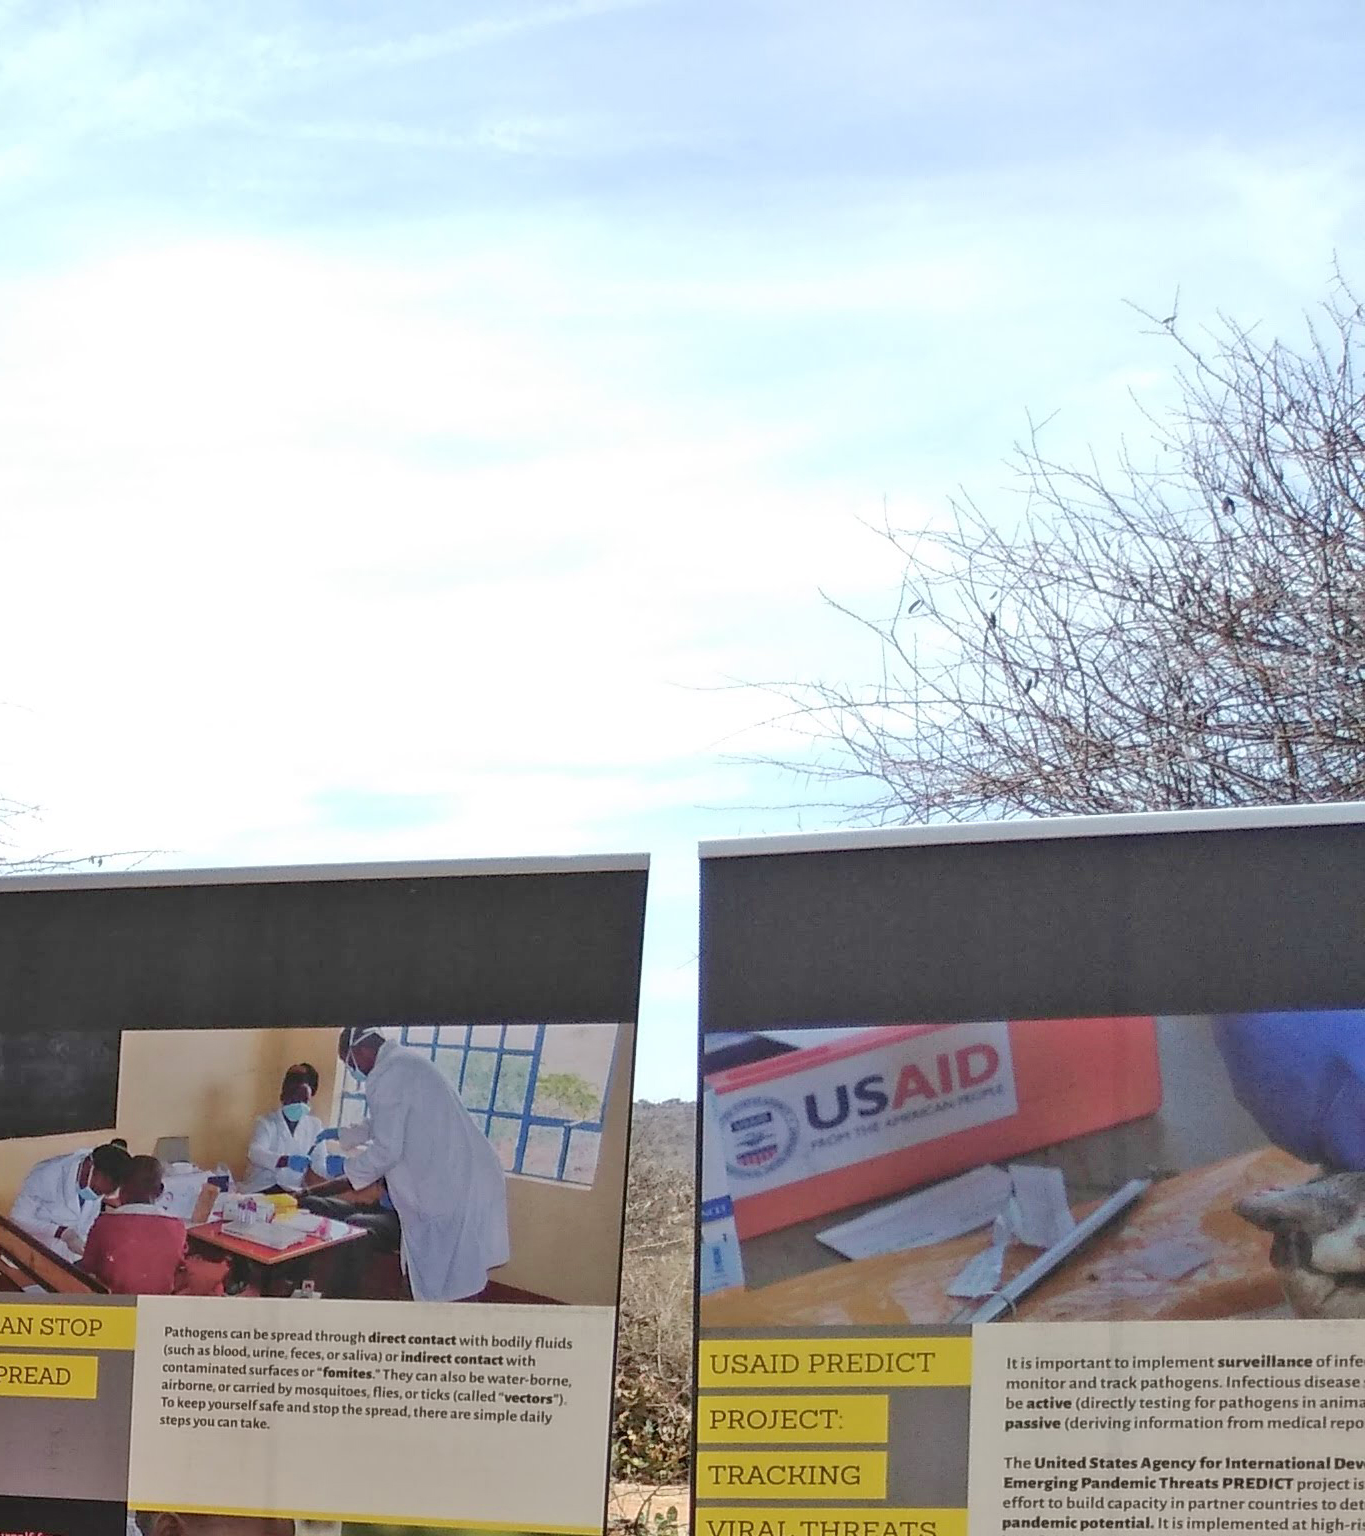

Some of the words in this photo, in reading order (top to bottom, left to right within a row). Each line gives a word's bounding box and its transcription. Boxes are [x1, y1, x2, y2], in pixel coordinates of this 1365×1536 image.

[805, 1043, 999, 1129] USAID
[39, 1317, 103, 1336] STOP
[164, 1326, 227, 1340] Pathogens
[229, 1330, 250, 1339] can
[253, 1328, 268, 1339] be
[270, 1330, 312, 1342] spread
[315, 1330, 365, 1345] through
[367, 1331, 406, 1343] direct
[407, 1335, 456, 1345] contact
[459, 1334, 488, 1346] with
[491, 1335, 532, 1350] bodily
[535, 1336, 573, 1349] fluids
[709, 1353, 799, 1373] USAID
[807, 1352, 936, 1372] PREDICT
[1007, 1357, 1017, 1369] It
[1020, 1356, 1031, 1369] is
[1035, 1357, 1111, 1371] important
[1114, 1358, 1129, 1368] to
[1132, 1355, 1214, 1370] implement
[1217, 1355, 1312, 1367] surveillance
[1315, 1354, 1331, 1367] of
[1005, 1377, 1066, 1389] monitor
[1068, 1376, 1096, 1388] and
[1100, 1376, 1136, 1388] track
[1140, 1376, 1222, 1391] pathogens.
[1226, 1375, 1300, 1388] Infectious
[1304, 1375, 1360, 1388] disease
[709, 1410, 843, 1430] PROJECT:
[1003, 1456, 1031, 1468] The
[1034, 1456, 1086, 1468] United
[1089, 1457, 1137, 1468] States
[1140, 1457, 1196, 1471] Agency
[1199, 1456, 1222, 1468] for
[1225, 1456, 1331, 1469] International
[708, 1466, 861, 1486] TRACKING
